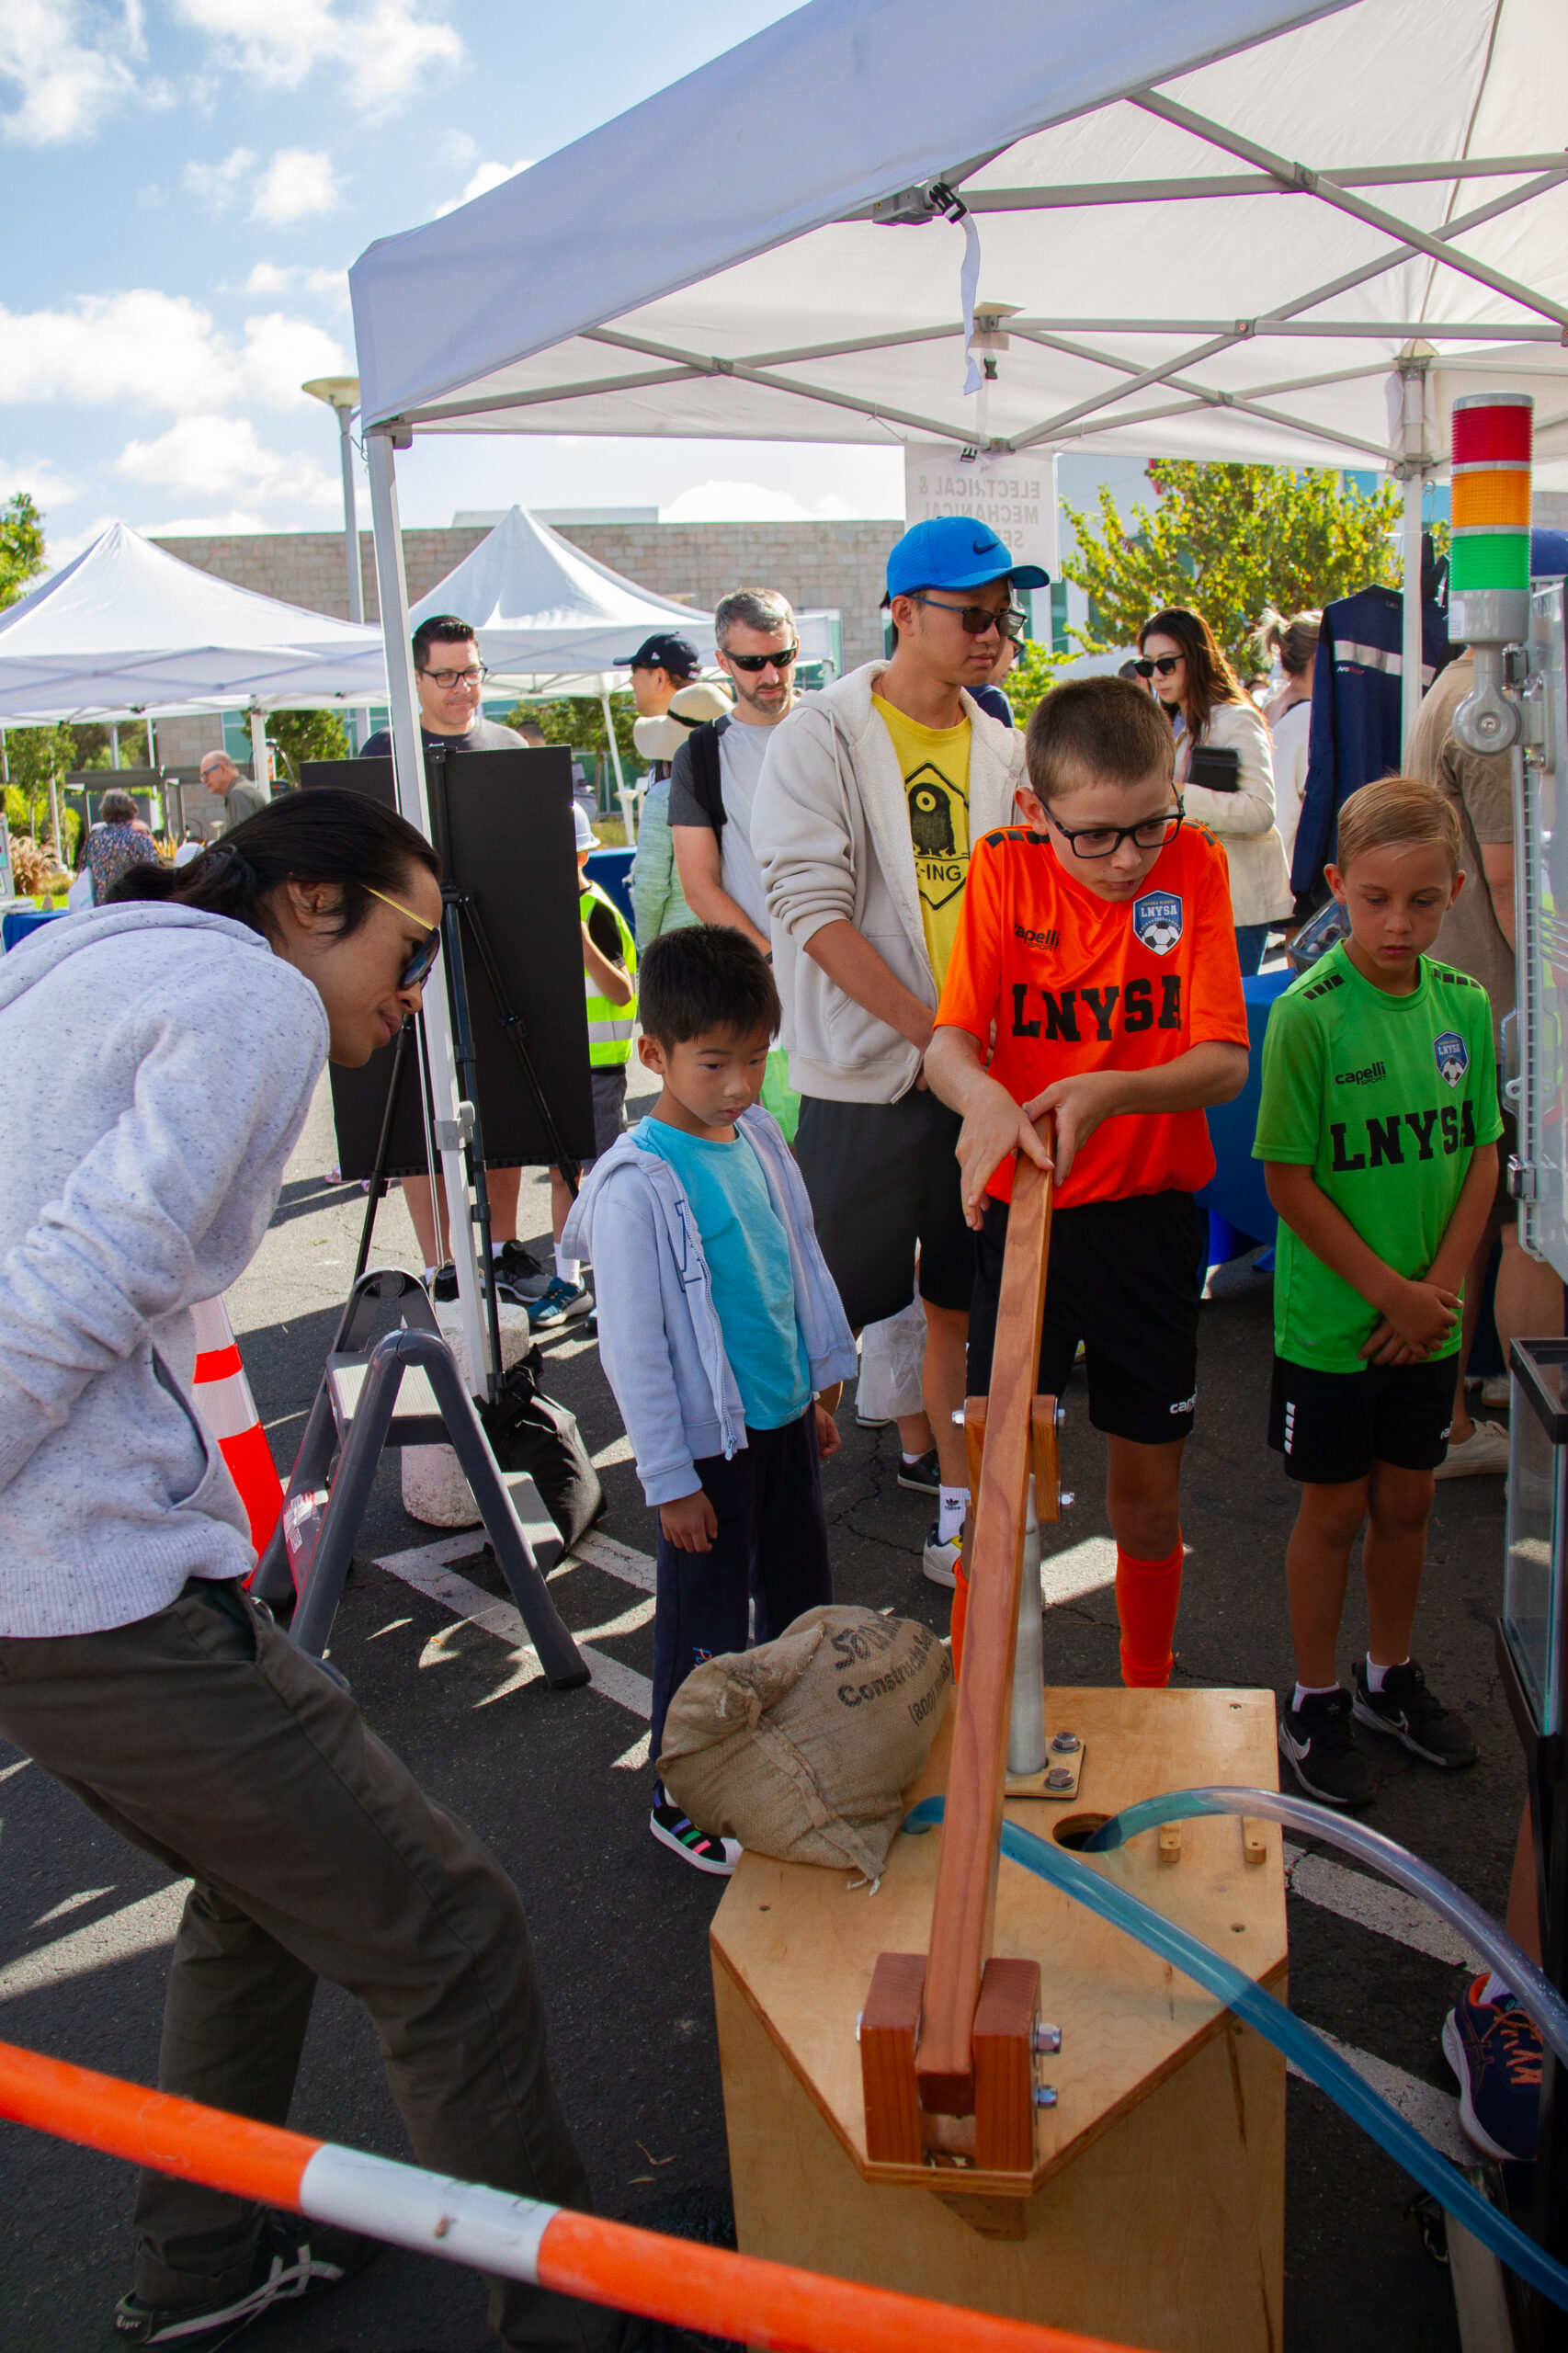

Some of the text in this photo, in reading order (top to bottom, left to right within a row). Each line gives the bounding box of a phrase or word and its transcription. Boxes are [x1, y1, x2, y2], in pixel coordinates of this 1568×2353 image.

[1141, 904, 1177, 918] LNYSA
[1014, 925, 1061, 947] apelli
[1028, 942, 1058, 952] SPORT
[1012, 974, 1182, 1042] LNYSA
[1335, 1061, 1386, 1086] capelli
[1330, 1100, 1475, 1173] LNYSA
[1169, 1392, 1198, 1415] cape
